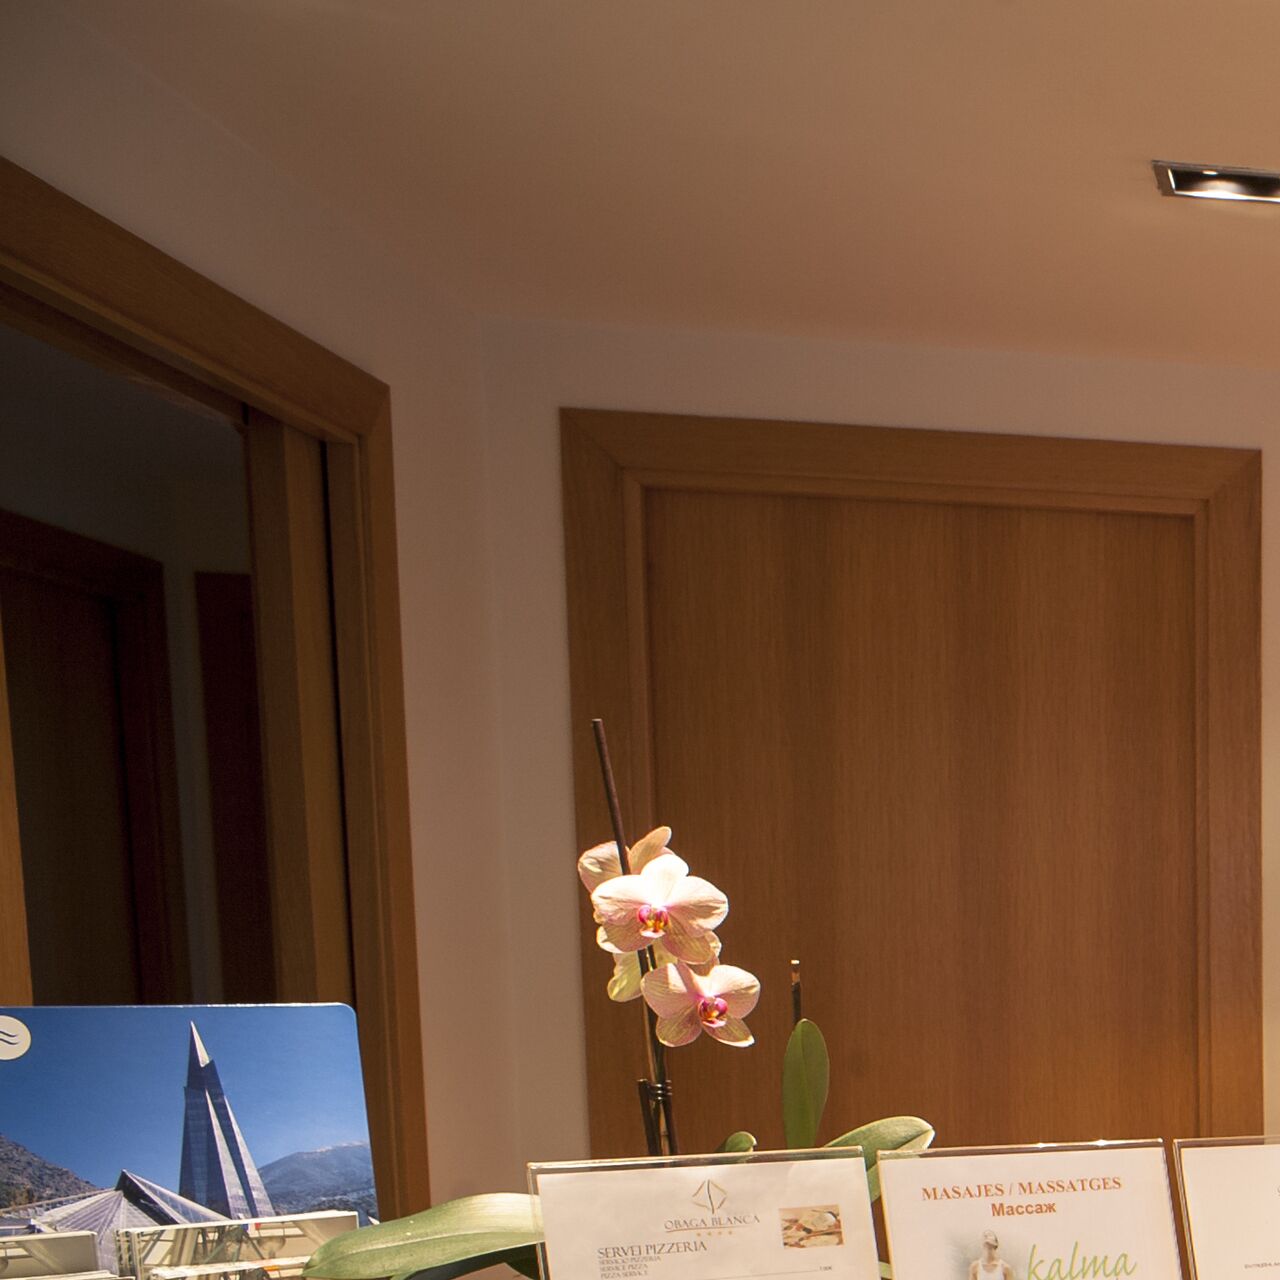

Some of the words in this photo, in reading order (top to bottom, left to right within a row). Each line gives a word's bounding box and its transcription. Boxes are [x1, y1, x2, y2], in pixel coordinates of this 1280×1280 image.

[922, 1184, 1004, 1201] MASAJES
[1009, 1183, 1014, 1195] /
[1018, 1176, 1122, 1195] MASSATGES
[991, 1203, 1057, 1217] Массаж
[664, 1217, 708, 1230] OBAGA
[712, 1214, 761, 1227] BLANCA
[597, 1244, 642, 1259] SERVEI
[645, 1240, 708, 1255] PIZZERIA
